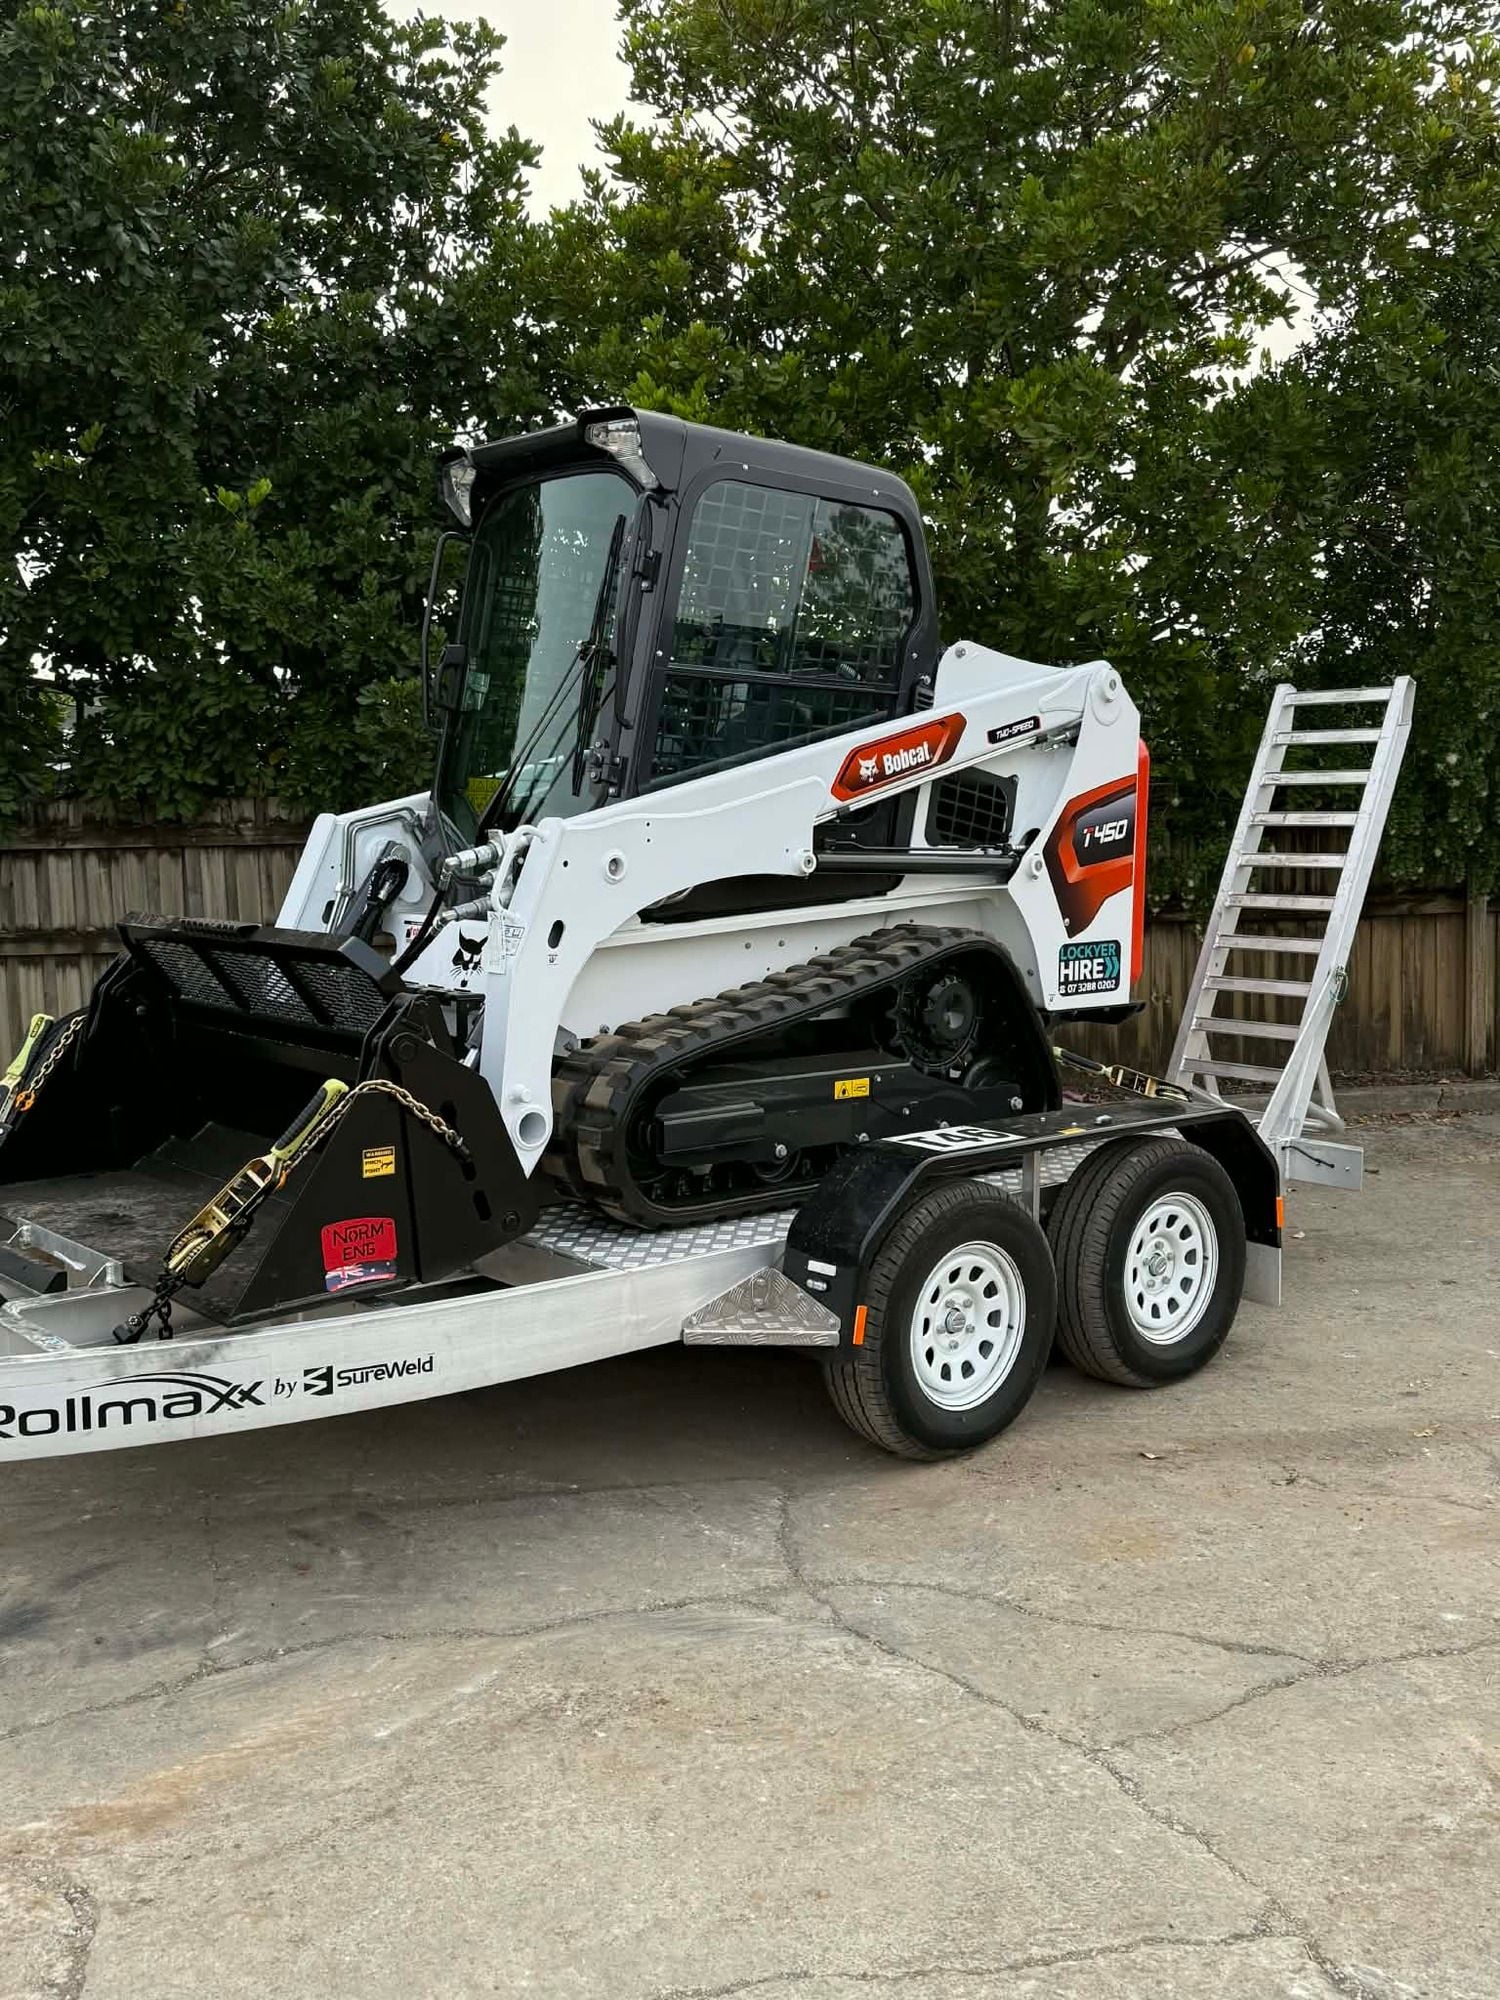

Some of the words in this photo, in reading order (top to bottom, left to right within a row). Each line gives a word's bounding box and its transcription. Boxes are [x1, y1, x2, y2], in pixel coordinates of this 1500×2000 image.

[882, 740, 930, 775] Bobcat
[1083, 819, 1128, 848] T450
[1060, 943, 1116, 960] LOCKYER
[1060, 957, 1104, 982] HIRE
[333, 1222, 384, 1246] NORM
[343, 1242, 375, 1261] ENG
[274, 1378, 298, 1398] by
[337, 1356, 433, 1387] SureWeld
